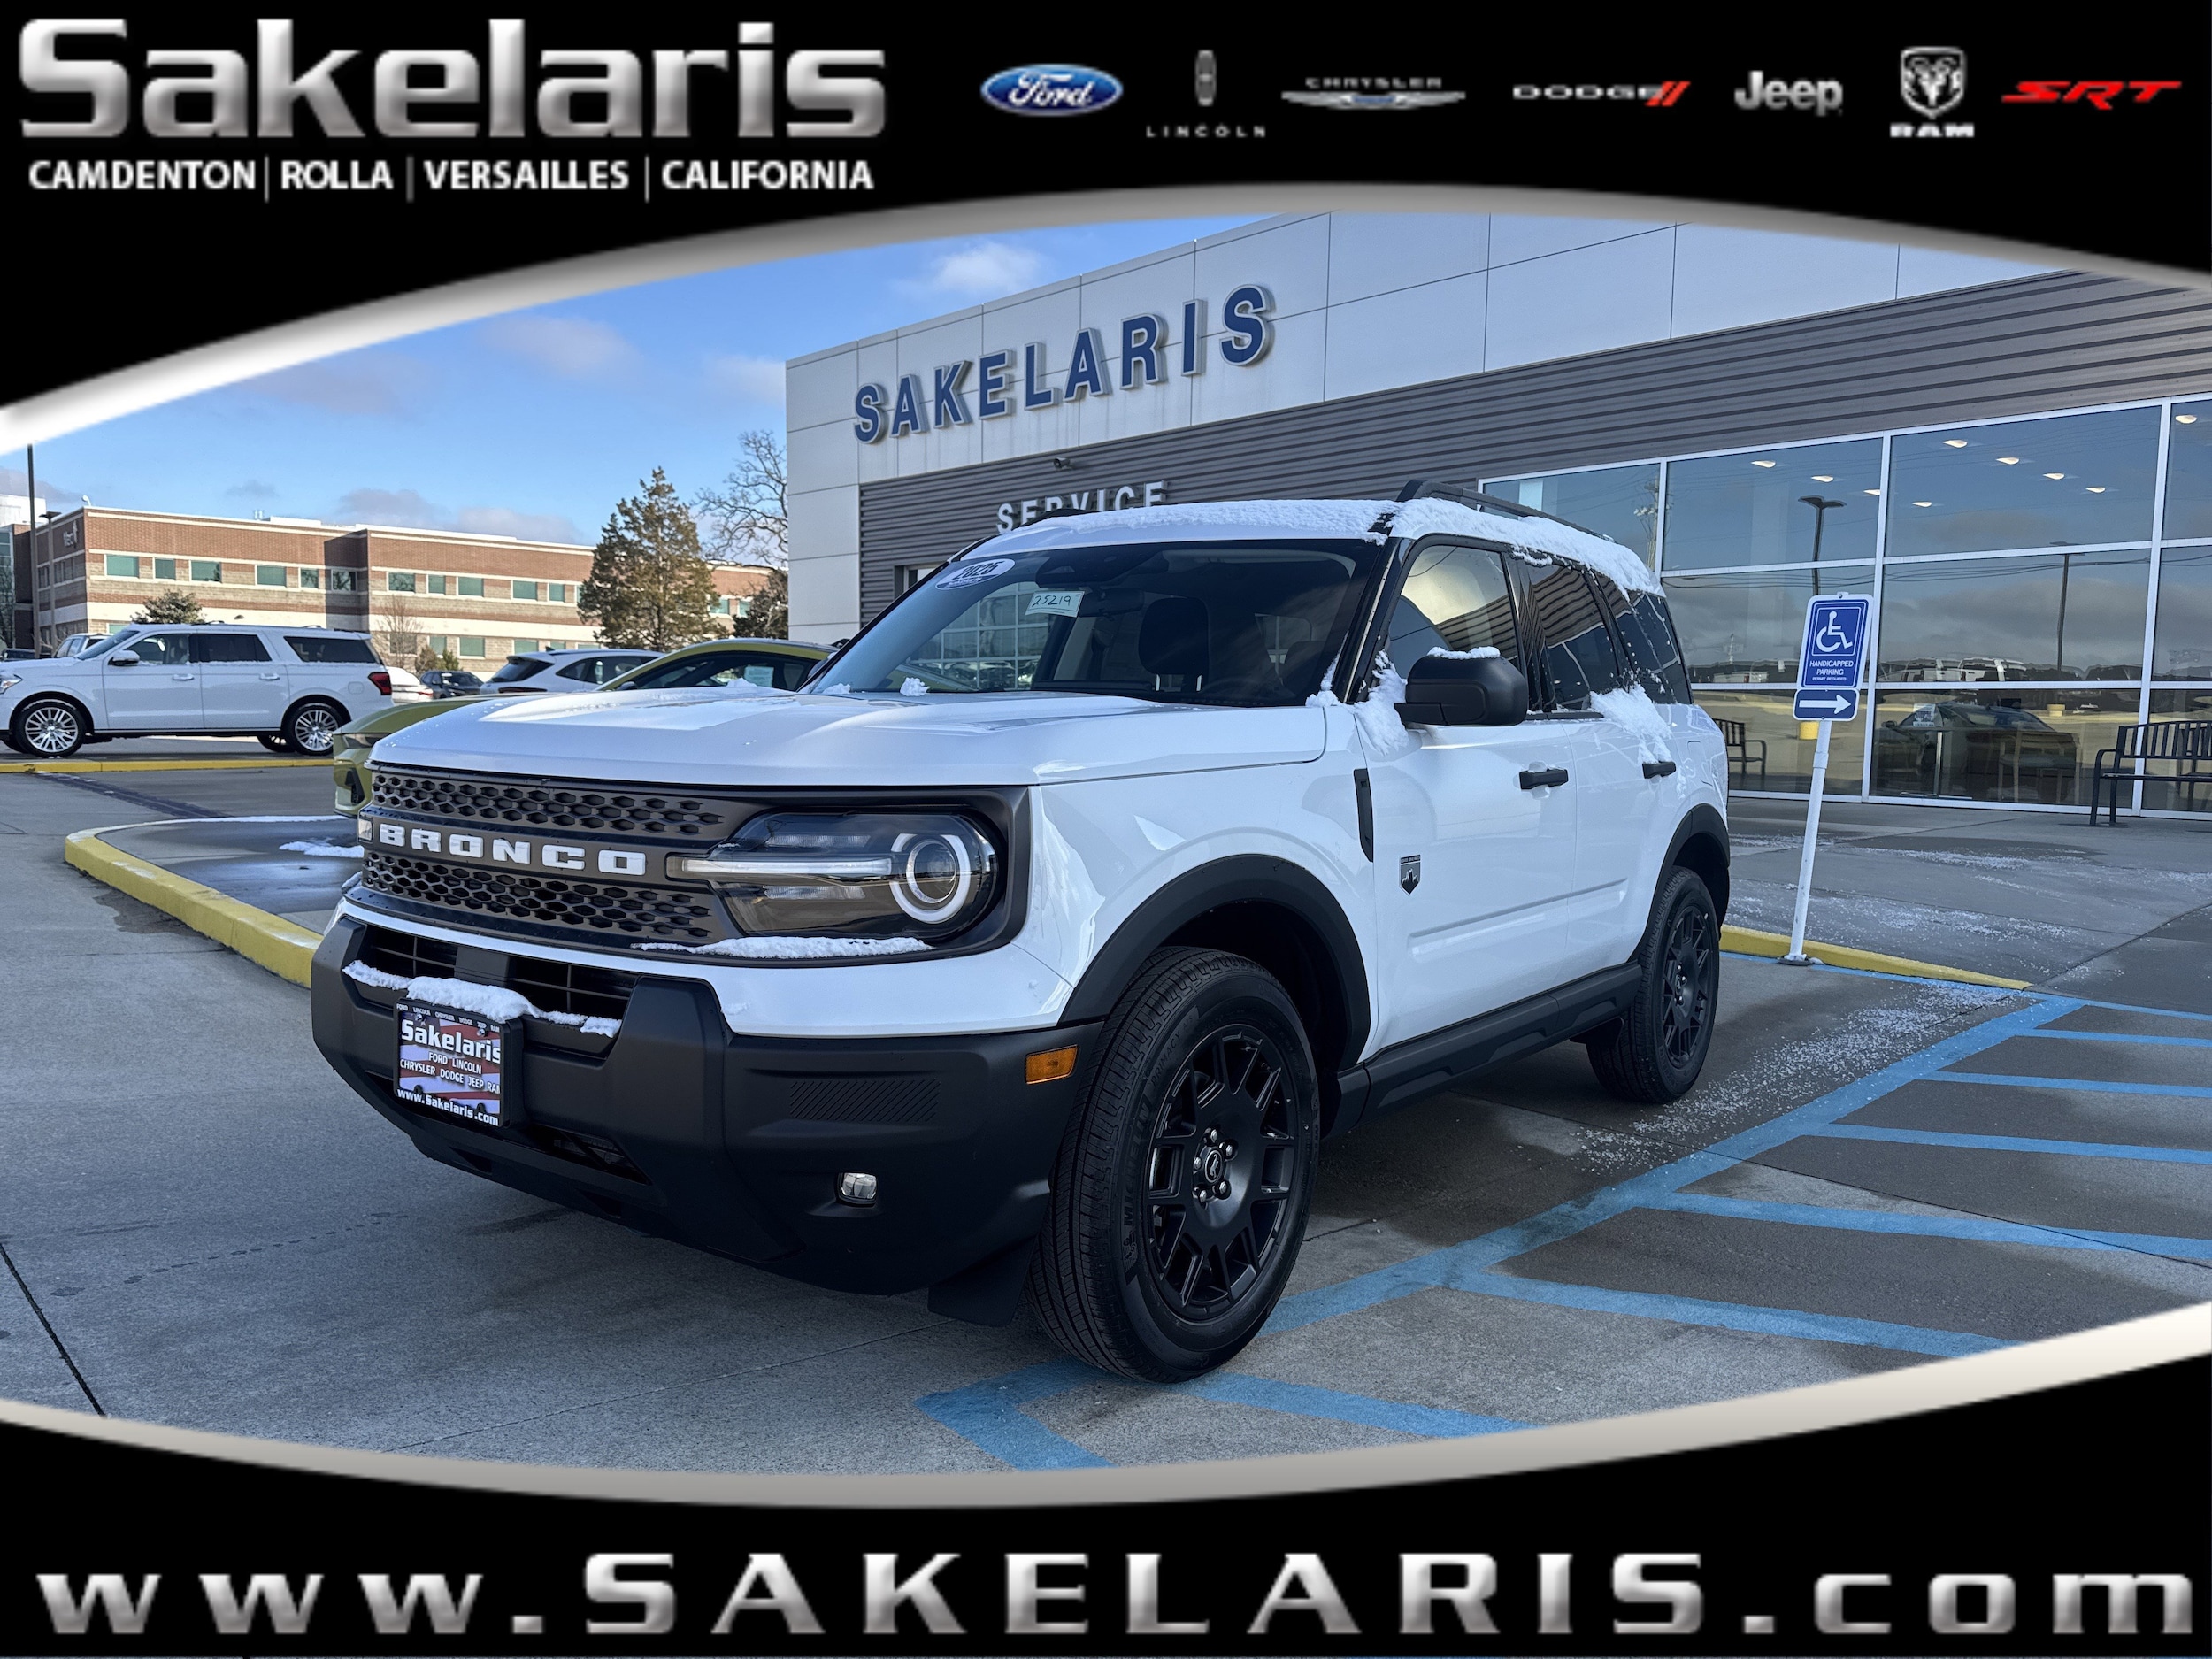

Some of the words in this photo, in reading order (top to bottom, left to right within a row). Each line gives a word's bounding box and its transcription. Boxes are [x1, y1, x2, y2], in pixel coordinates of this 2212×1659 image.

[853, 284, 1274, 444] SAKELARIS
[951, 560, 1005, 580] 2025
[1031, 594, 1071, 608] 25219
[379, 823, 646, 876] BRONCO
[412, 1007, 431, 1016] LINCOLN
[434, 1011, 456, 1022] CHRYSLER
[458, 1017, 473, 1026] DODGE
[401, 1019, 501, 1064] Sakelaris
[1151, 1029, 1183, 1086] PRIMACY
[399, 1059, 436, 1076] CHRYSLER
[440, 1069, 465, 1084] DODGE
[467, 1076, 485, 1089] JEEP
[428, 1052, 449, 1065] FORD
[451, 1058, 482, 1075] LINCOLN
[396, 1089, 500, 1127] www.Sakelaris.com
[1123, 1094, 1151, 1228] MICHELIN
